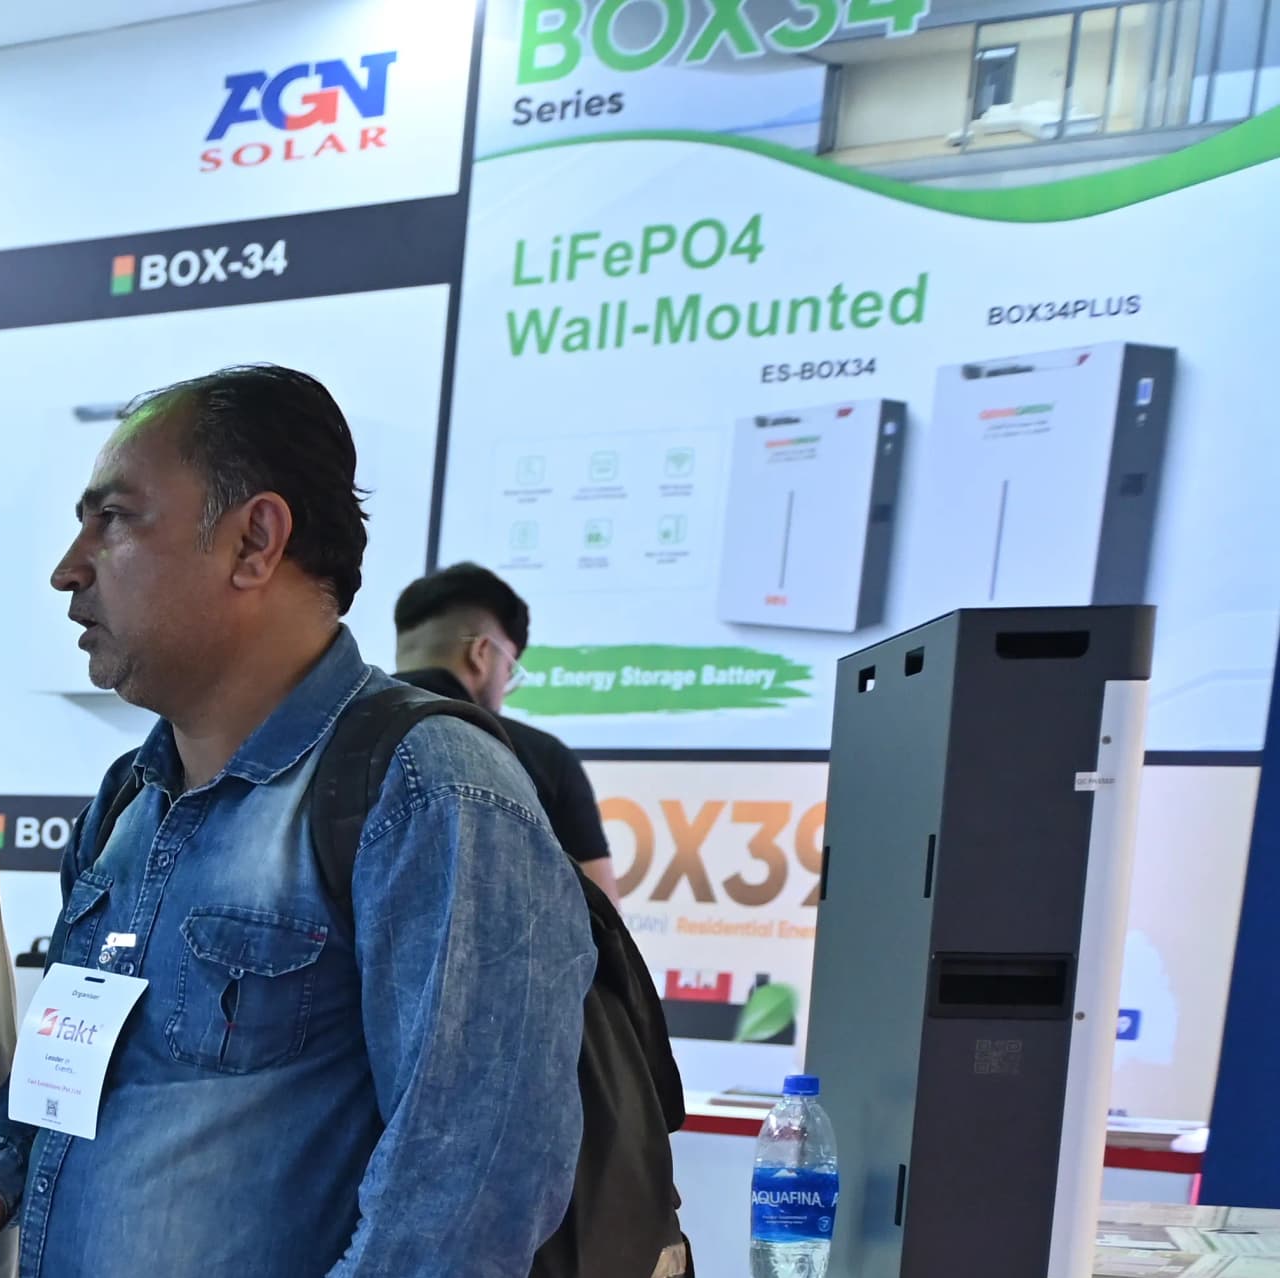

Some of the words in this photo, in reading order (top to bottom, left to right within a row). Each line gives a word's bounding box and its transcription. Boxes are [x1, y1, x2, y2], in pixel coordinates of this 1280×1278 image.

[204, 50, 398, 142] AGN
[512, 88, 626, 127] Series
[199, 126, 389, 173] SOLAR
[140, 240, 288, 291] BOX-34
[512, 213, 765, 287] LiFePO4
[505, 272, 929, 356] Wall-Mounted
[986, 294, 1142, 328] BOX34PLUS
[761, 356, 877, 385] ES-BOX34
[550, 666, 617, 692] Energy
[620, 665, 696, 691] Storage
[700, 664, 777, 690] Battery
[15, 815, 78, 850] BO
[56, 1016, 98, 1045] fakt
[751, 1190, 825, 1208] AQUAFINA
